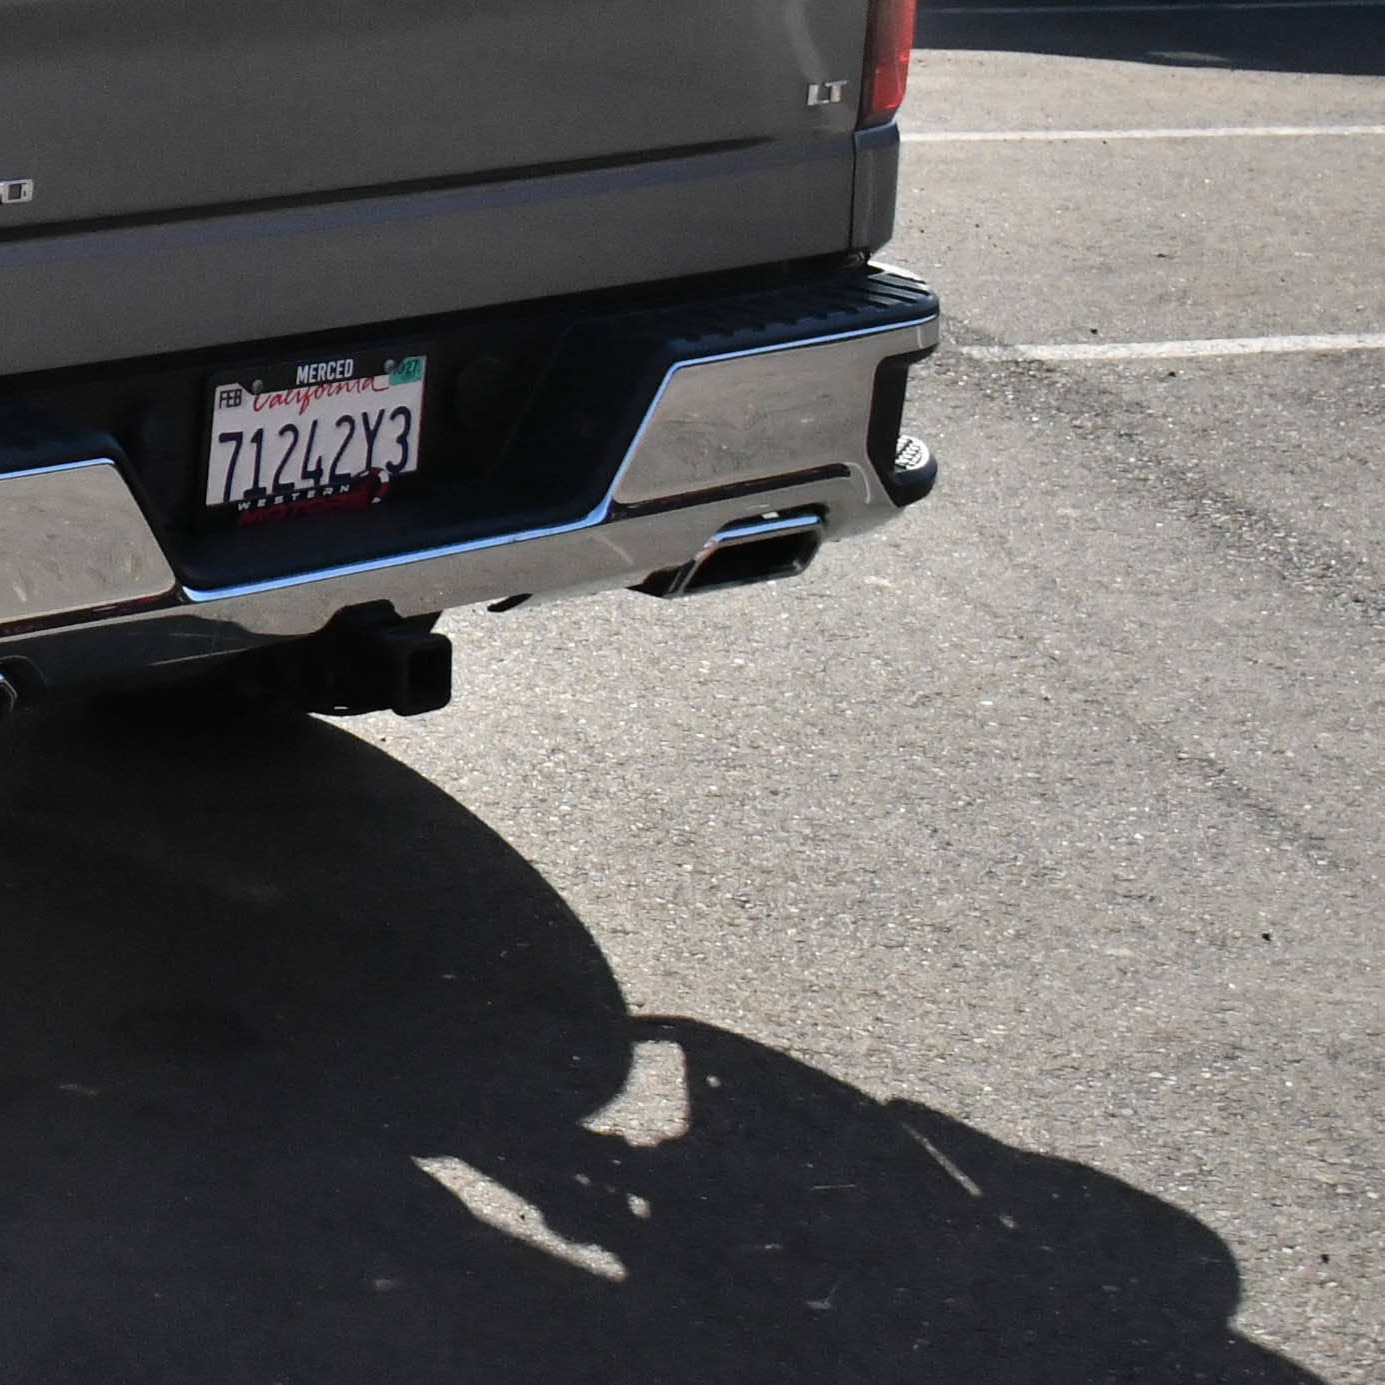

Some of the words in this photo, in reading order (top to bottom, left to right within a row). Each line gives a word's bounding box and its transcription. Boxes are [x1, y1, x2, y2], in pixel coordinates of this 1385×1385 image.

[807, 79, 848, 106] LT
[296, 358, 354, 385] MERCED
[218, 388, 243, 409] FEB
[251, 376, 389, 415] California
[217, 406, 412, 503] 71242Y3
[237, 483, 351, 512] WESTERN
